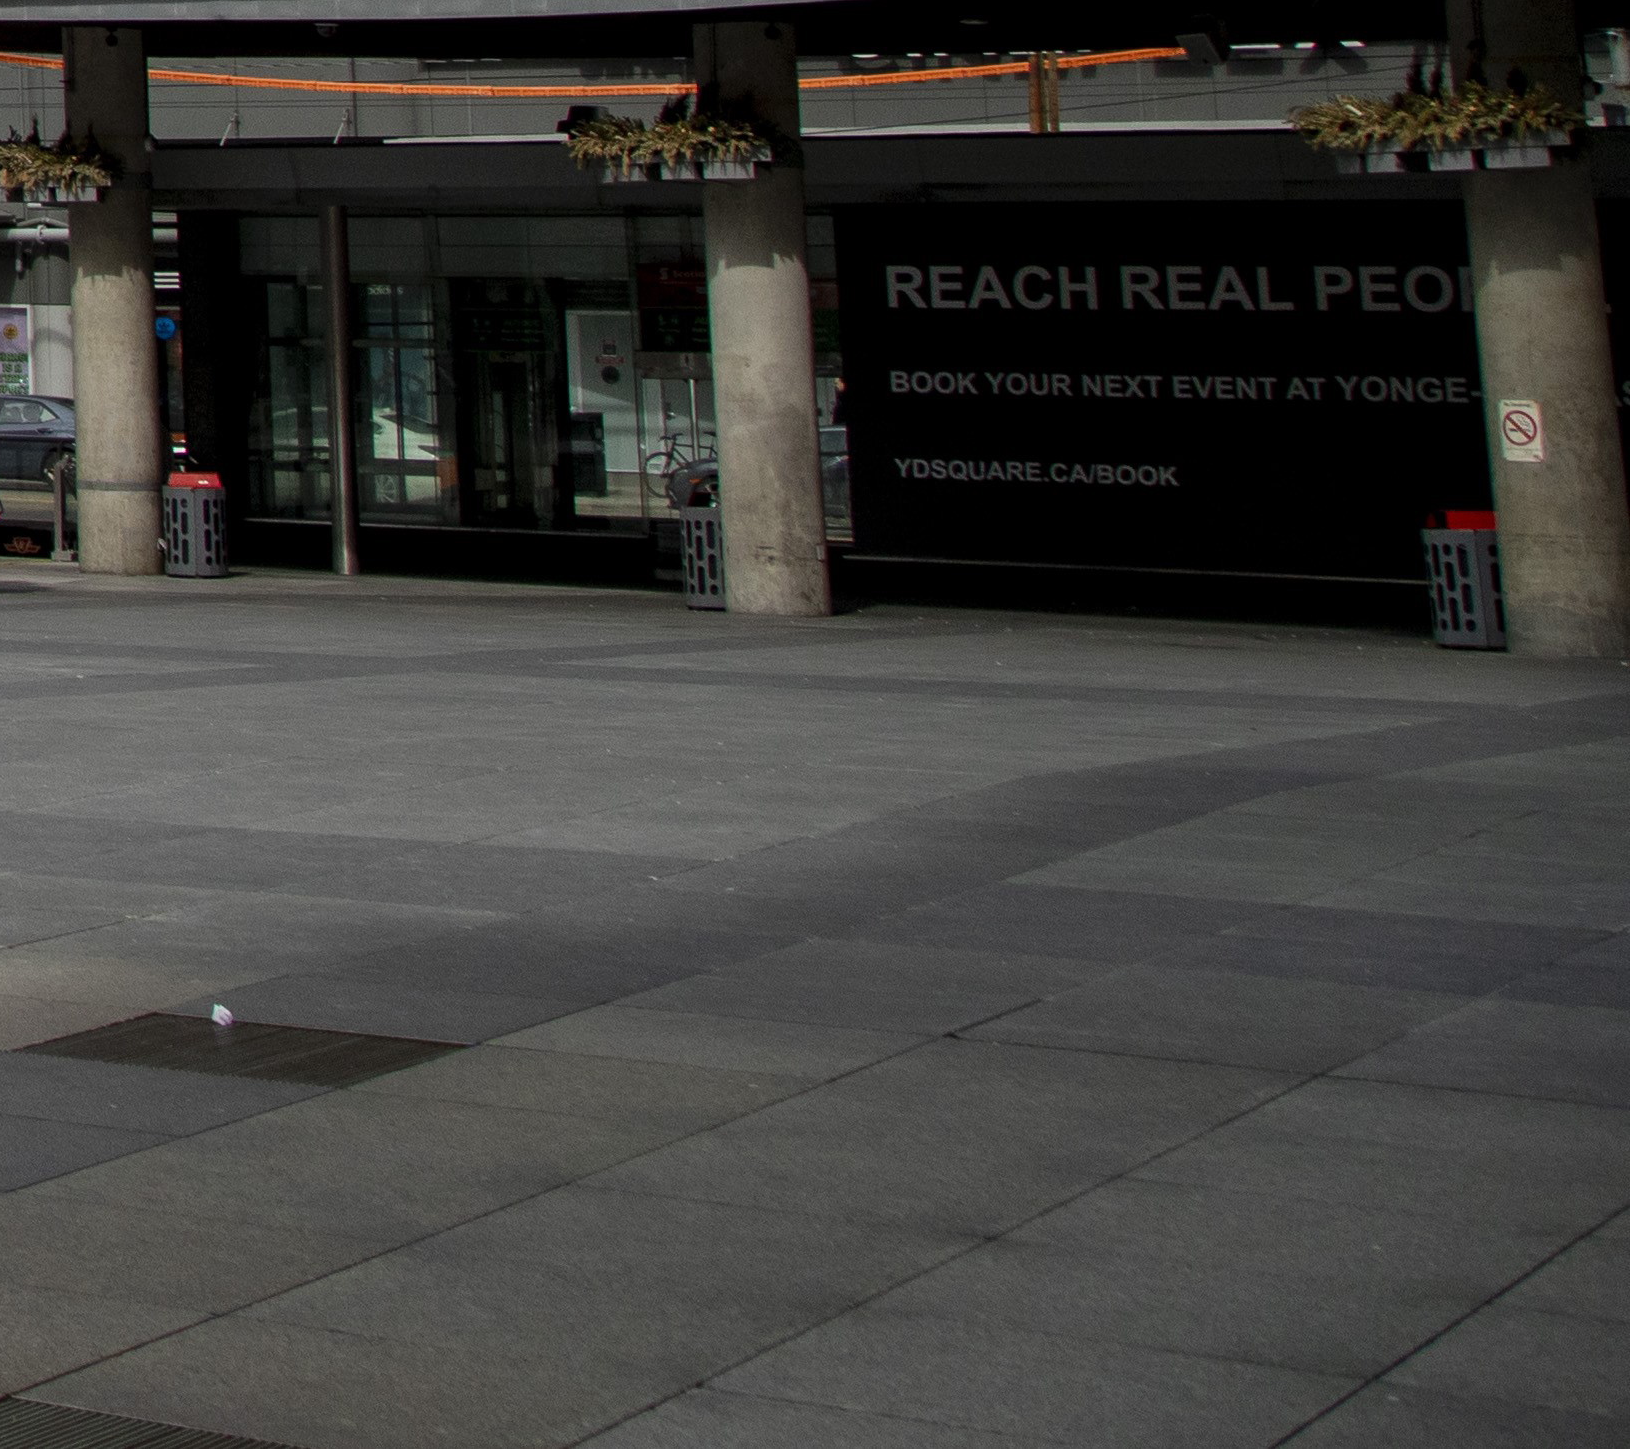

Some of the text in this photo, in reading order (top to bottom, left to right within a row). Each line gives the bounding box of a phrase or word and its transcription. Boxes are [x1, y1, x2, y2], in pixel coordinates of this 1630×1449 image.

[886, 265, 1479, 314] REACH REAL PEO
[889, 369, 1482, 405] BOOK YOUR NEXT EVENT AT YONGE-
[894, 456, 1181, 488] YDSQUARE.CA/BOOK
